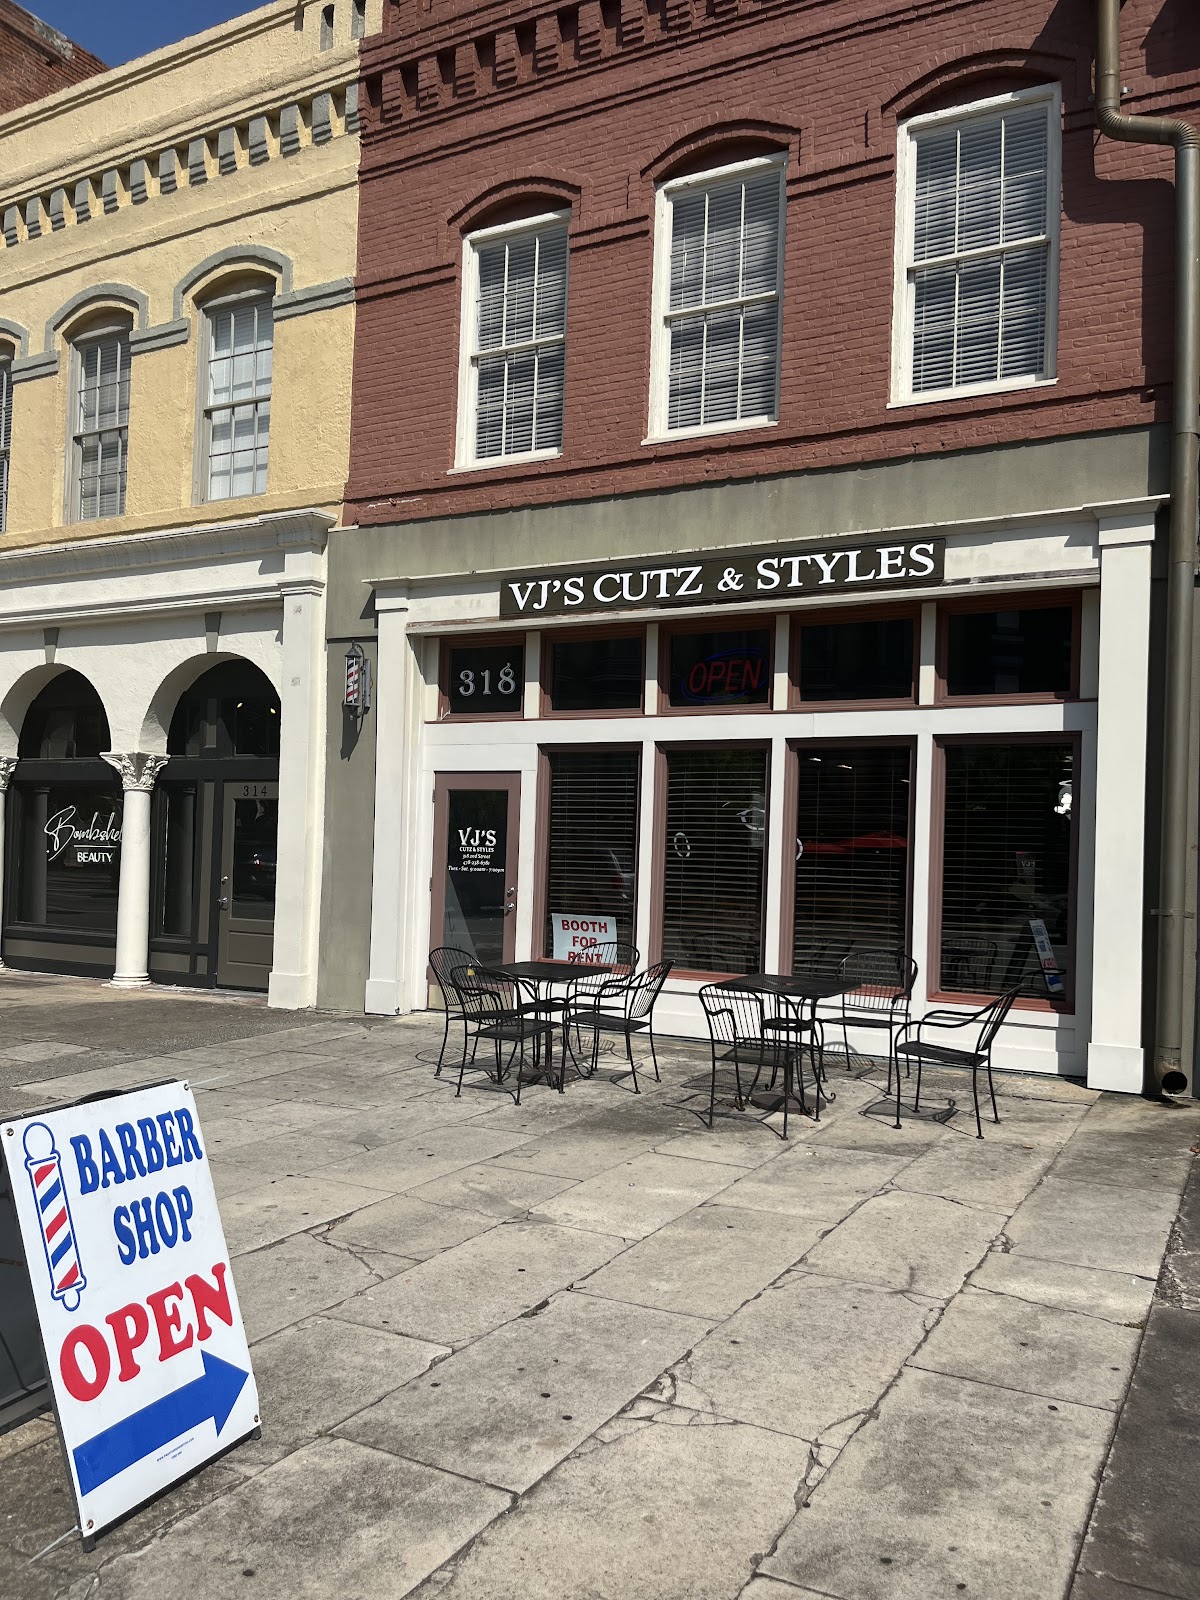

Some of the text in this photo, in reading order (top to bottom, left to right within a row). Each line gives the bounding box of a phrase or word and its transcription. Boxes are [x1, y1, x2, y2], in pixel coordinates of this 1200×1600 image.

[508, 542, 936, 612] VJ'S CUTZ & STYLES
[457, 662, 517, 698] 318
[688, 657, 763, 696] OPEN
[242, 785, 268, 798] 314
[457, 826, 497, 847] VJ'S
[77, 852, 113, 863] BEAUTY
[561, 920, 608, 933] BOOTH
[572, 935, 598, 948] FOR
[70, 1107, 203, 1196] BARBER
[113, 1184, 194, 1266] SHOP
[59, 1261, 234, 1403] OPEN
